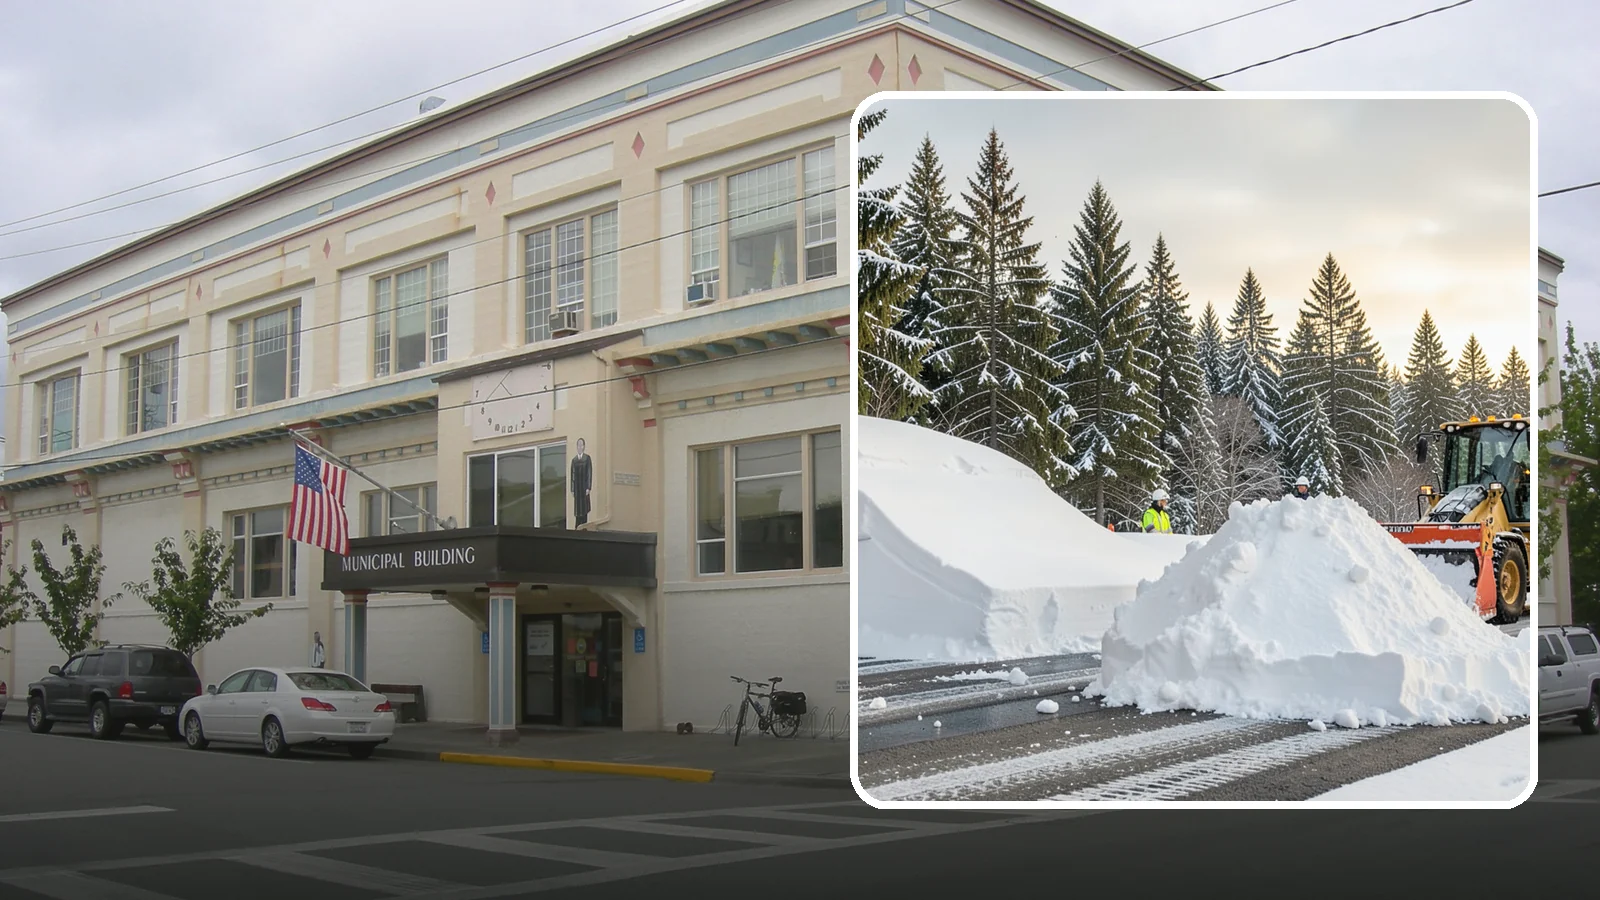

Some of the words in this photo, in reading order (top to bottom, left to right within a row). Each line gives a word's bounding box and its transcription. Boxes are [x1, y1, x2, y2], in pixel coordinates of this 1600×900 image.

[480, 406, 485, 415] 8
[535, 402, 540, 410] 4
[487, 417, 492, 426] 9
[528, 413, 533, 422] 3
[494, 423, 500, 432] 10
[521, 420, 526, 428] 2
[507, 425, 513, 433] 12
[342, 552, 405, 572] MUNICIPAL
[414, 546, 475, 567] BUILDING
